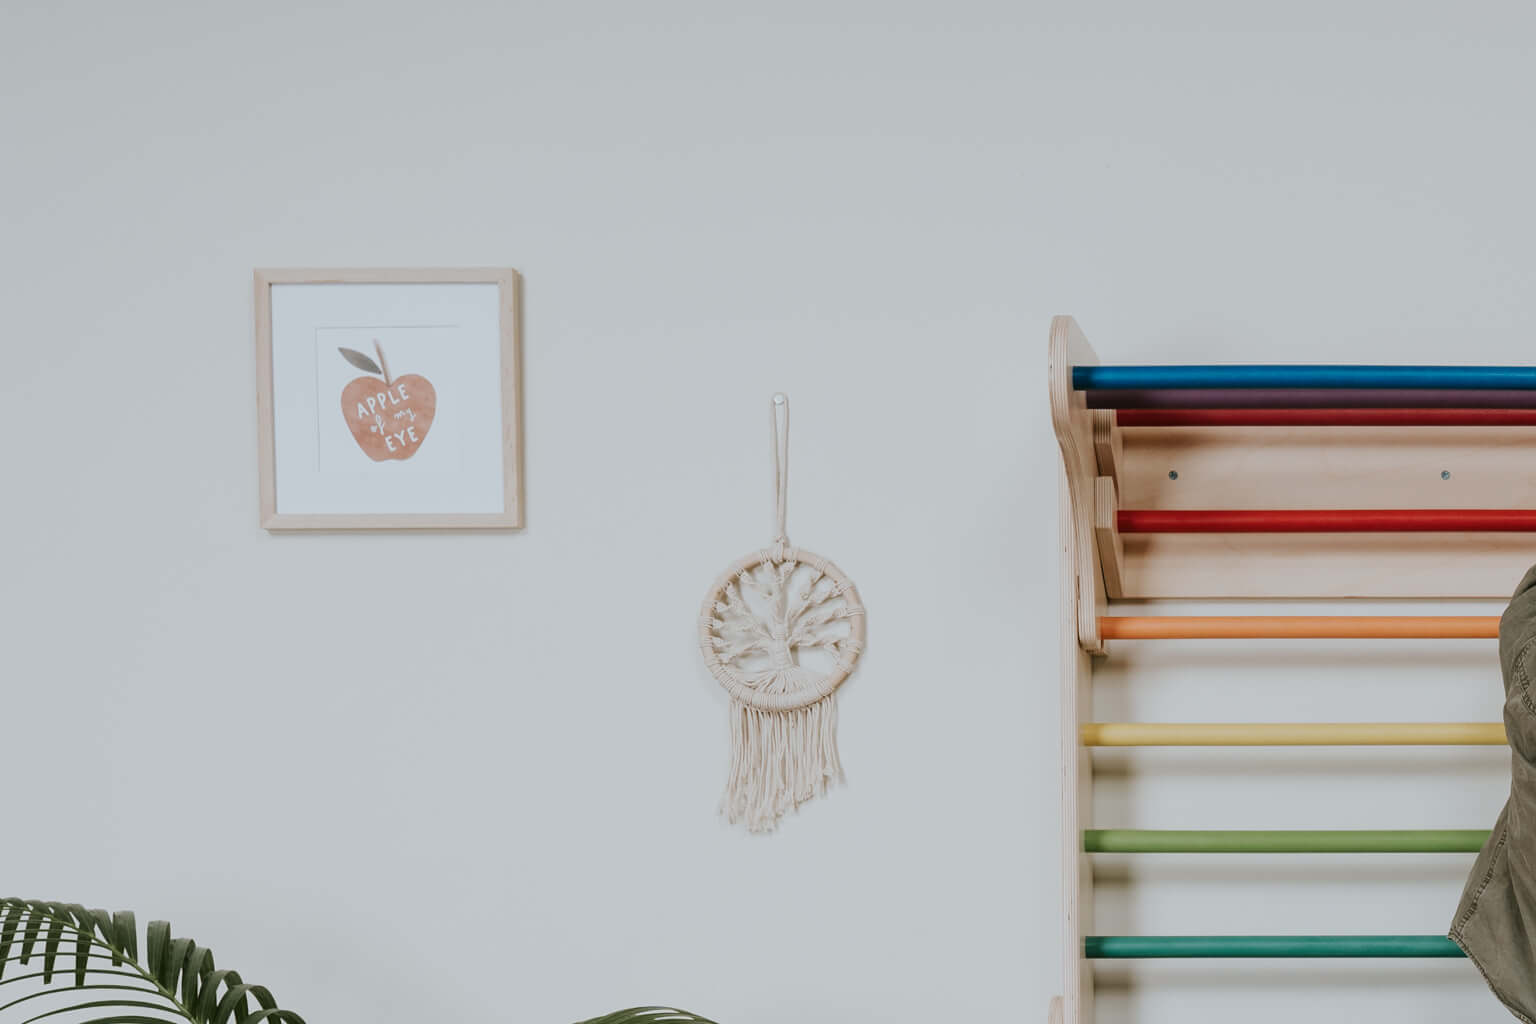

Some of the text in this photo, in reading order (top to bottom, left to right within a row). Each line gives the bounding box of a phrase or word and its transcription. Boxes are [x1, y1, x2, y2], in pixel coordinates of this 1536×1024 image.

[357, 384, 409, 419] APPLE
[370, 408, 416, 435] of my
[385, 426, 419, 452] EYE
